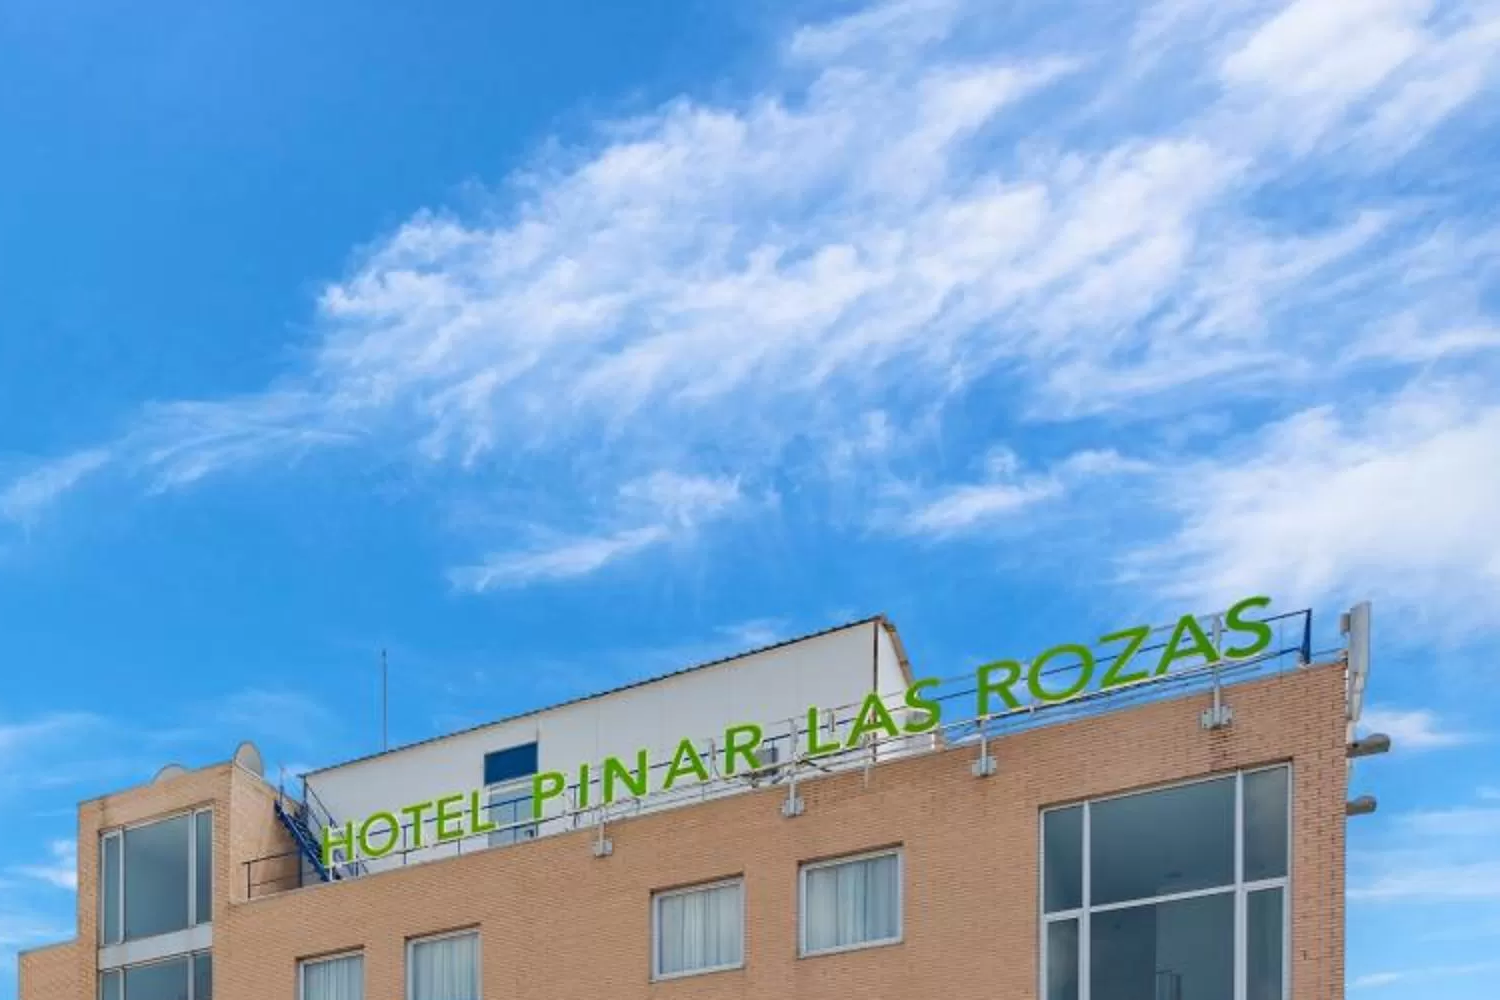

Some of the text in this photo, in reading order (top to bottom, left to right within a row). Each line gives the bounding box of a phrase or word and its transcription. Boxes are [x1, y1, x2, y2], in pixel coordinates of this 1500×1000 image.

[319, 596, 1273, 869] HOTEL PINAR LAS ROZAS
